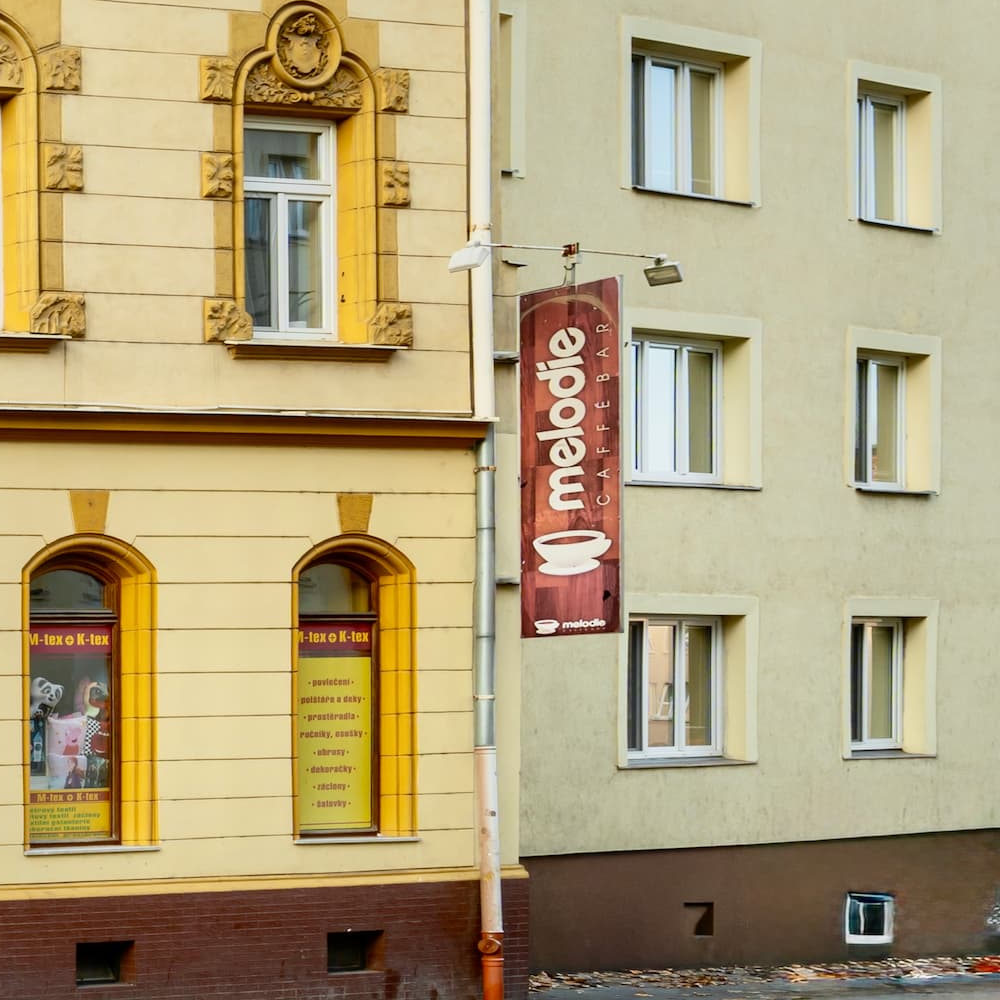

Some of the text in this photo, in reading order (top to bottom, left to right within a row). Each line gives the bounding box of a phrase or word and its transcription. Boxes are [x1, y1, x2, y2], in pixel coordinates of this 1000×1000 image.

[536, 327, 585, 511] melodie
[562, 619, 606, 629] melodie
[77, 633, 109, 646] K-tex
[339, 630, 369, 643] K-tex
